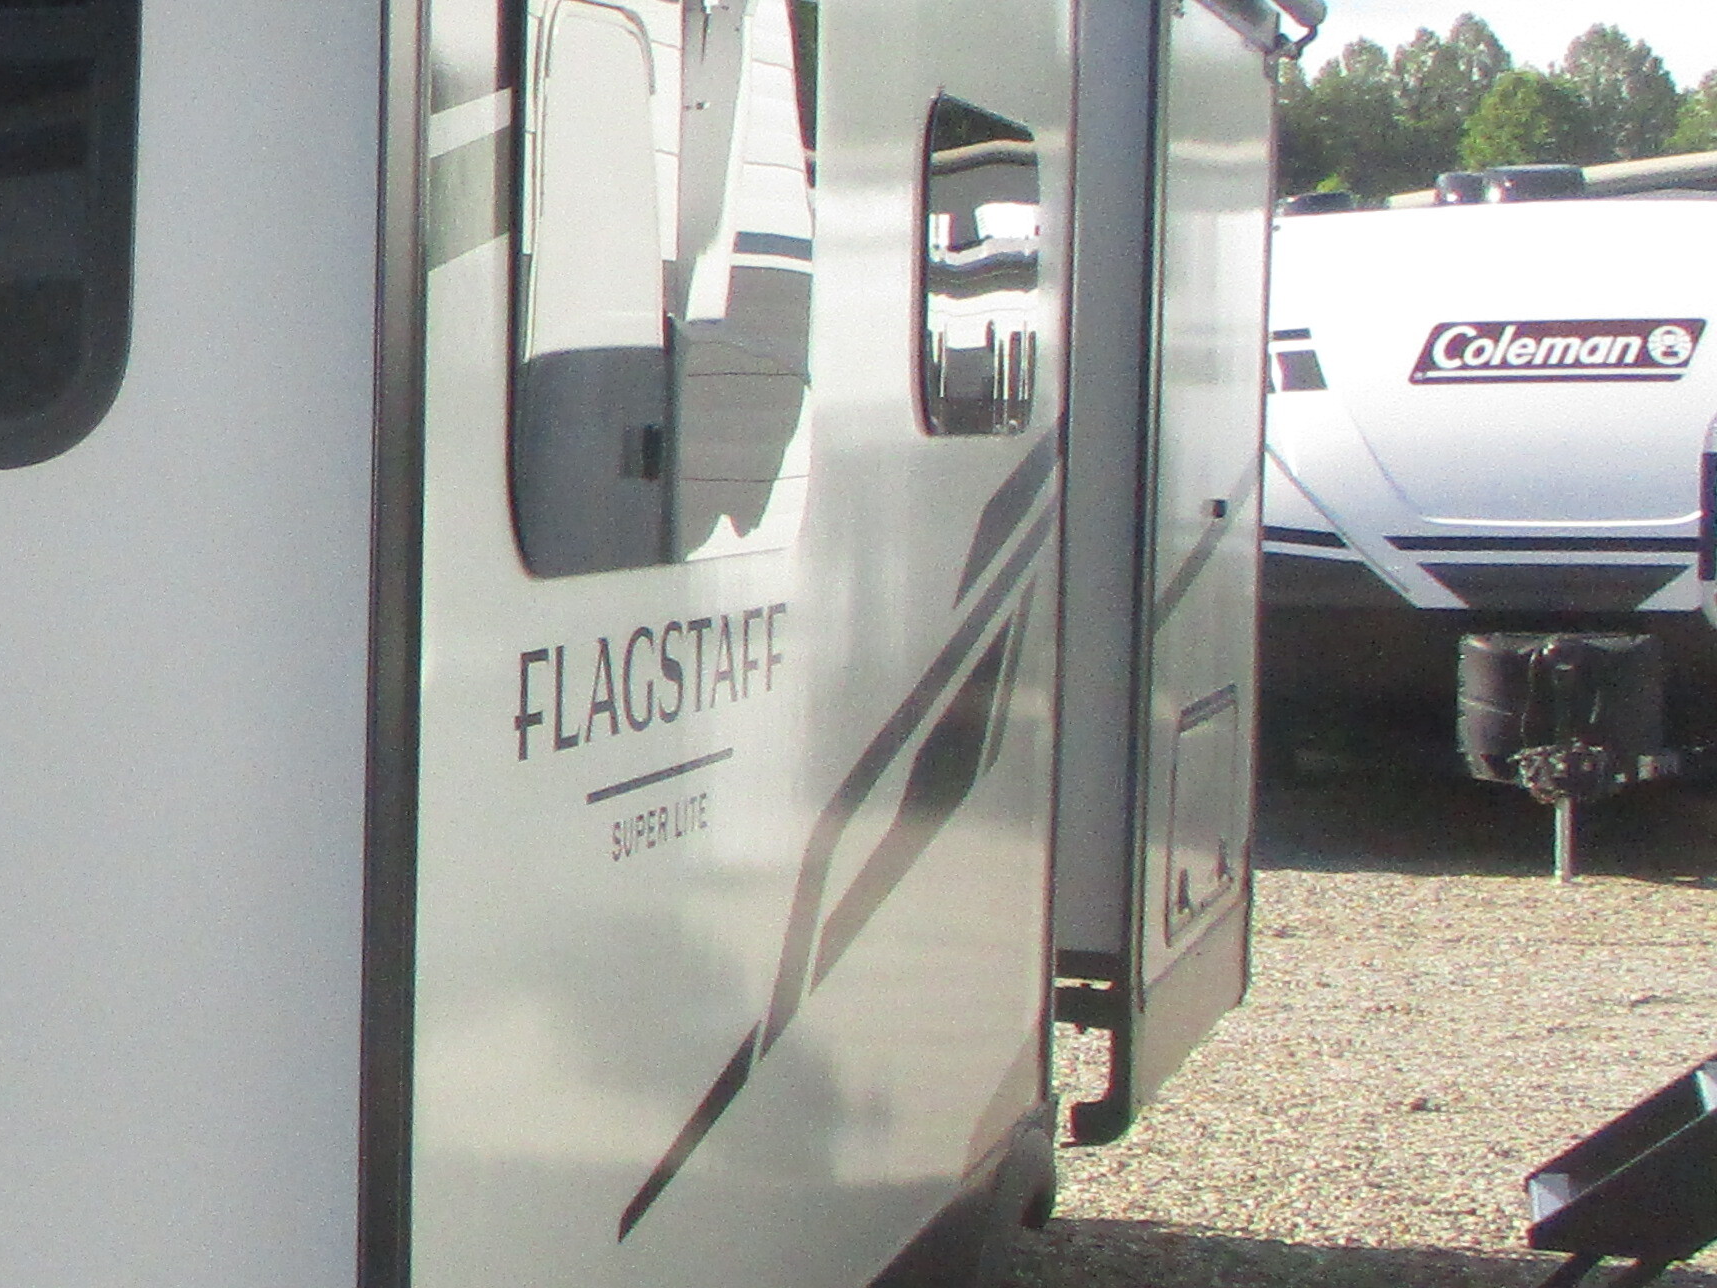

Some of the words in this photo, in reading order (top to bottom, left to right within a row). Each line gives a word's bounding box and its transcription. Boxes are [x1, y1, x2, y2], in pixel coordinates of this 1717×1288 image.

[1432, 324, 1643, 370] Coleman
[513, 602, 787, 761] FLAGSTAFF
[611, 806, 668, 862] SUPER
[674, 792, 709, 839] LITE
